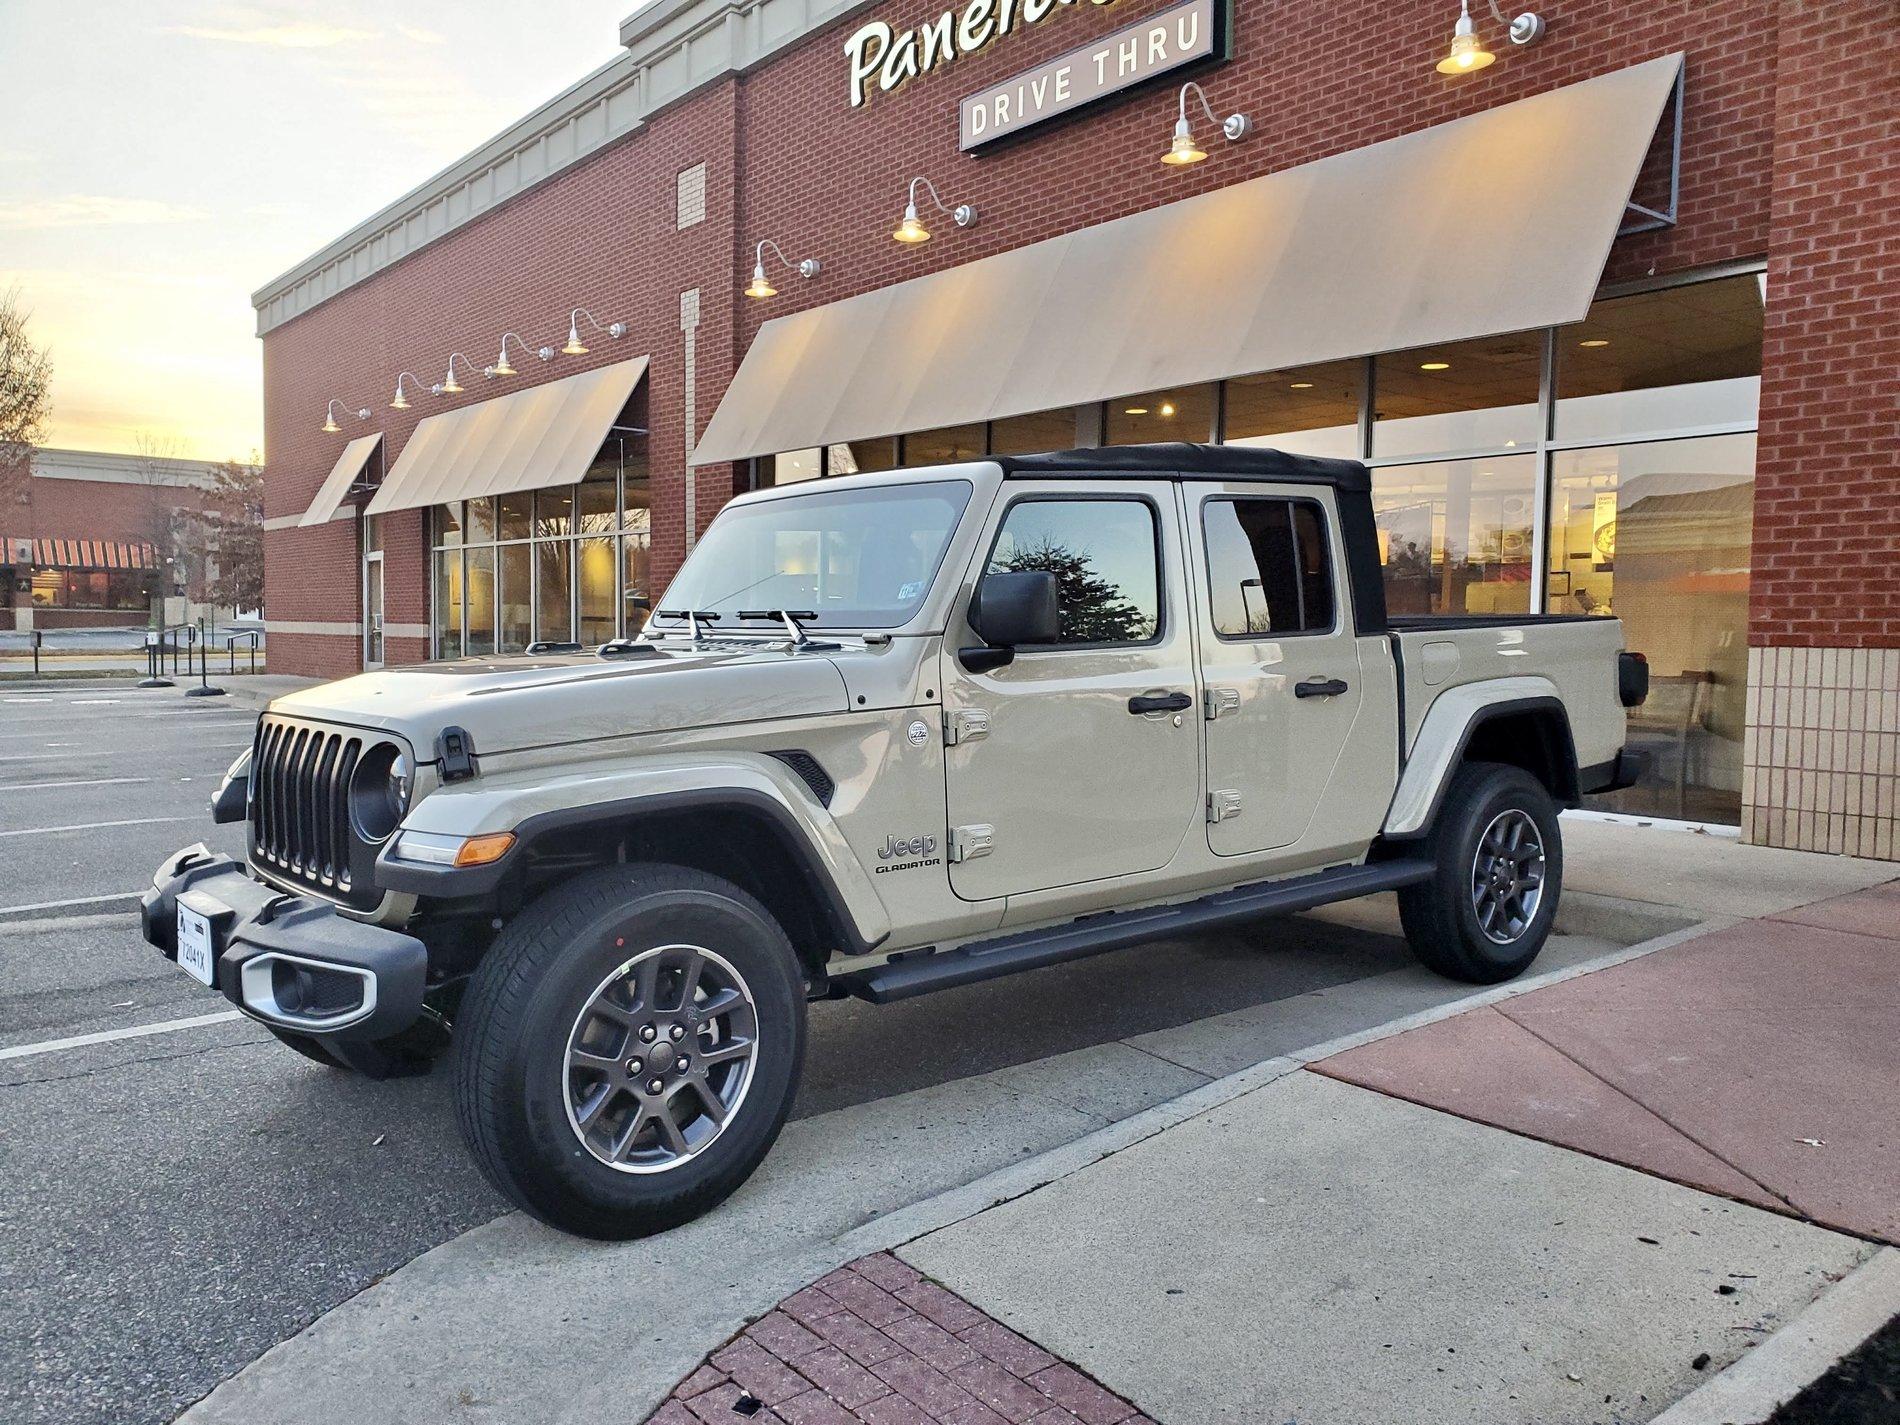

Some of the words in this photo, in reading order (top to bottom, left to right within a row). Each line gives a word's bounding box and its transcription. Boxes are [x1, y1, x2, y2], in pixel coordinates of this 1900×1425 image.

[971, 65, 1073, 136] DRIVE
[1092, 11, 1199, 87] THRU
[877, 833, 937, 859] Jeep
[875, 858, 941, 874] GLADIATOR
